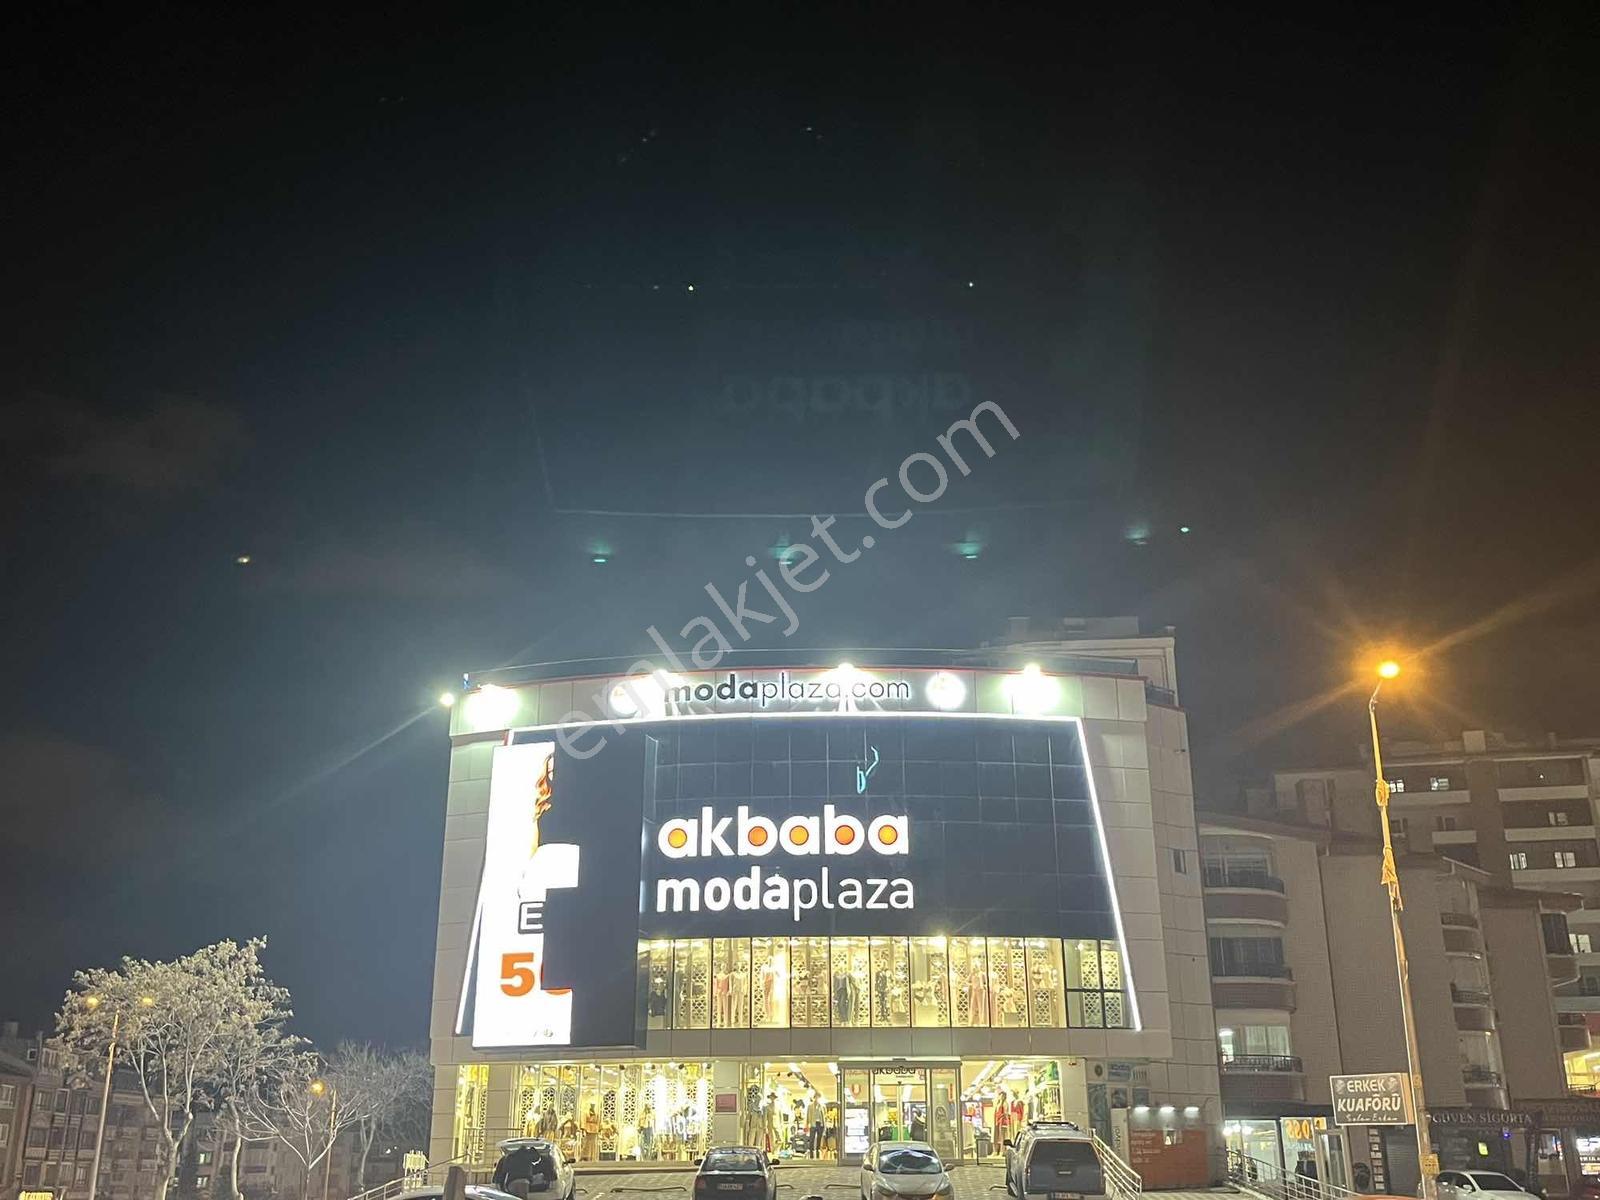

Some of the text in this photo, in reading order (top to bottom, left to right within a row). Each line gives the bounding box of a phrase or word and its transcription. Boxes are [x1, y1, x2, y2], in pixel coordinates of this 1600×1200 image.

[665, 671, 910, 706] modaplaza.com
[657, 804, 909, 858] akbaba
[656, 865, 914, 921] modaplaza
[1337, 1092, 1401, 1112] KUAFÖRÜ
[1346, 1078, 1387, 1092] ERKEK
